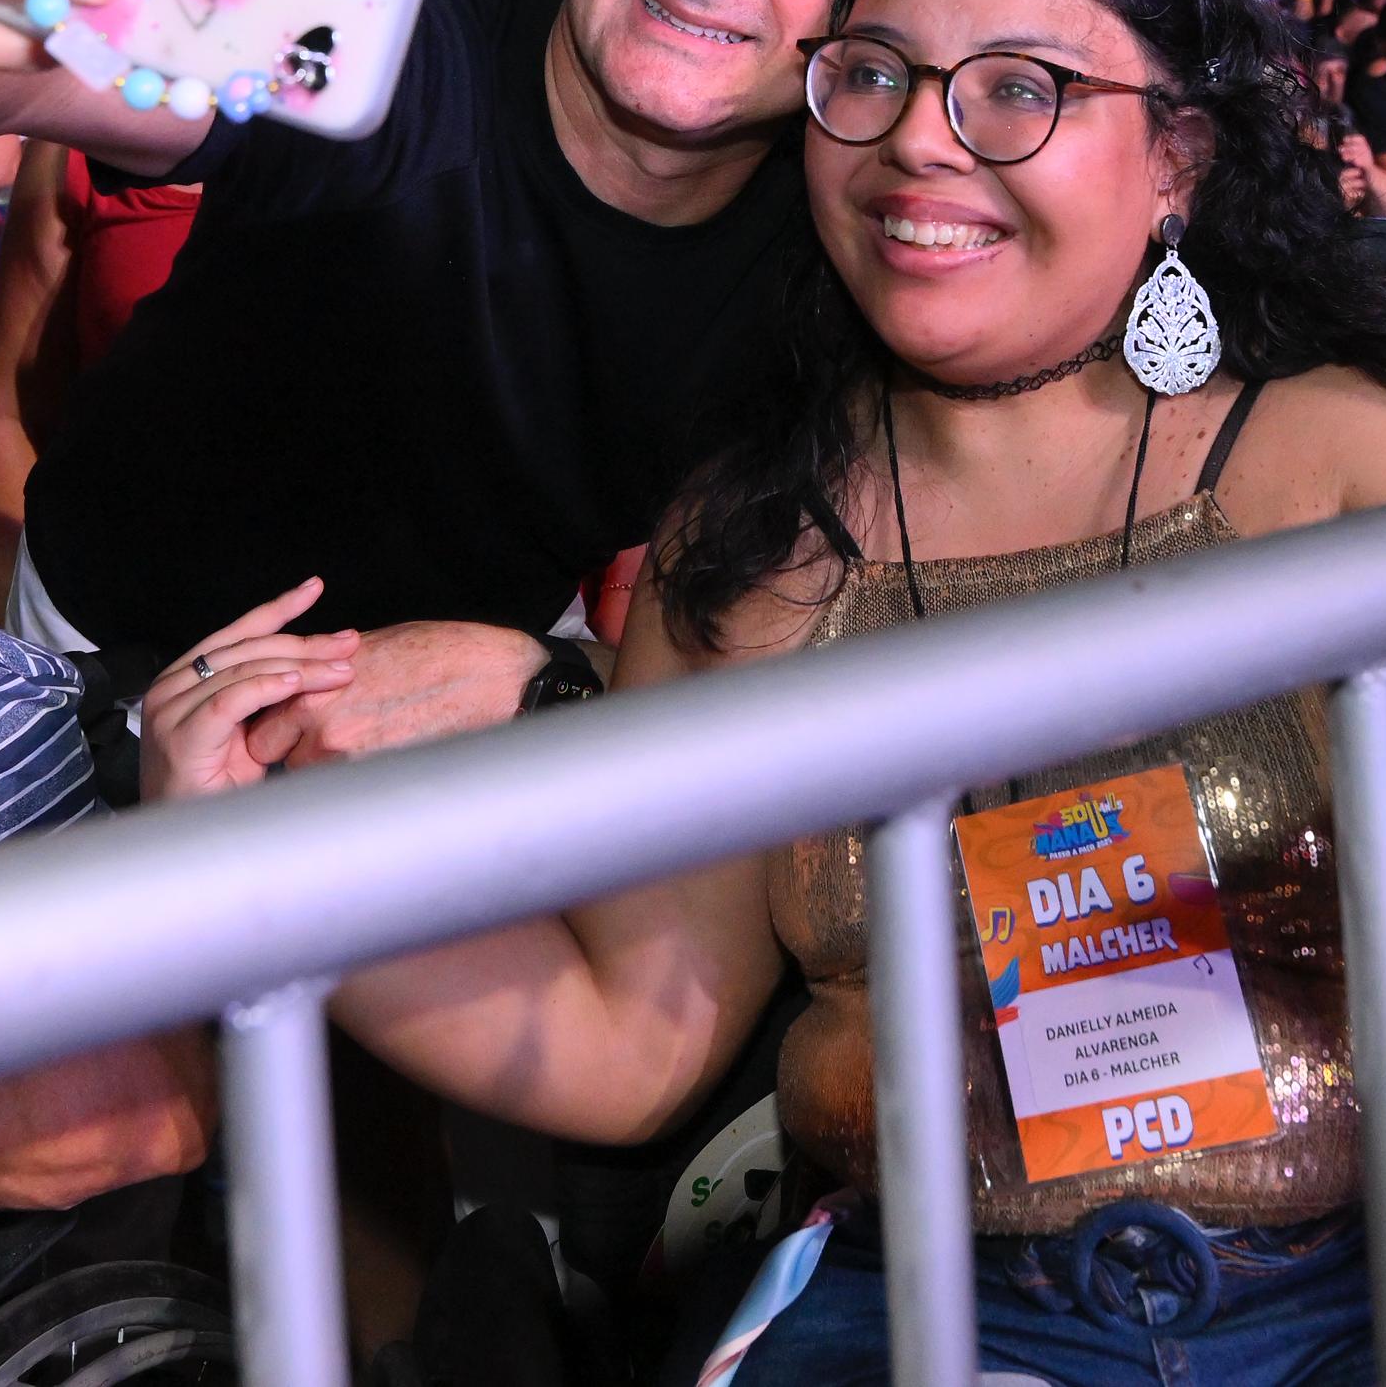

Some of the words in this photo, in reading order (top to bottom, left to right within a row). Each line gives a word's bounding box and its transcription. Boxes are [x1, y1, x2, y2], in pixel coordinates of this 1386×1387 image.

[1027, 866, 1113, 928] DIA
[1122, 854, 1156, 905] 6
[1040, 917, 1178, 976] MALCHER
[1046, 1014, 1113, 1041] DANIELLY
[1116, 1002, 1178, 1026] ALMEIDA
[1075, 1031, 1159, 1060] ALVARENGA
[1064, 1069, 1089, 1087] DIA
[1091, 1068, 1100, 1082] 6
[1110, 1051, 1181, 1078] MALCHER
[1102, 1095, 1194, 1160] PCD
